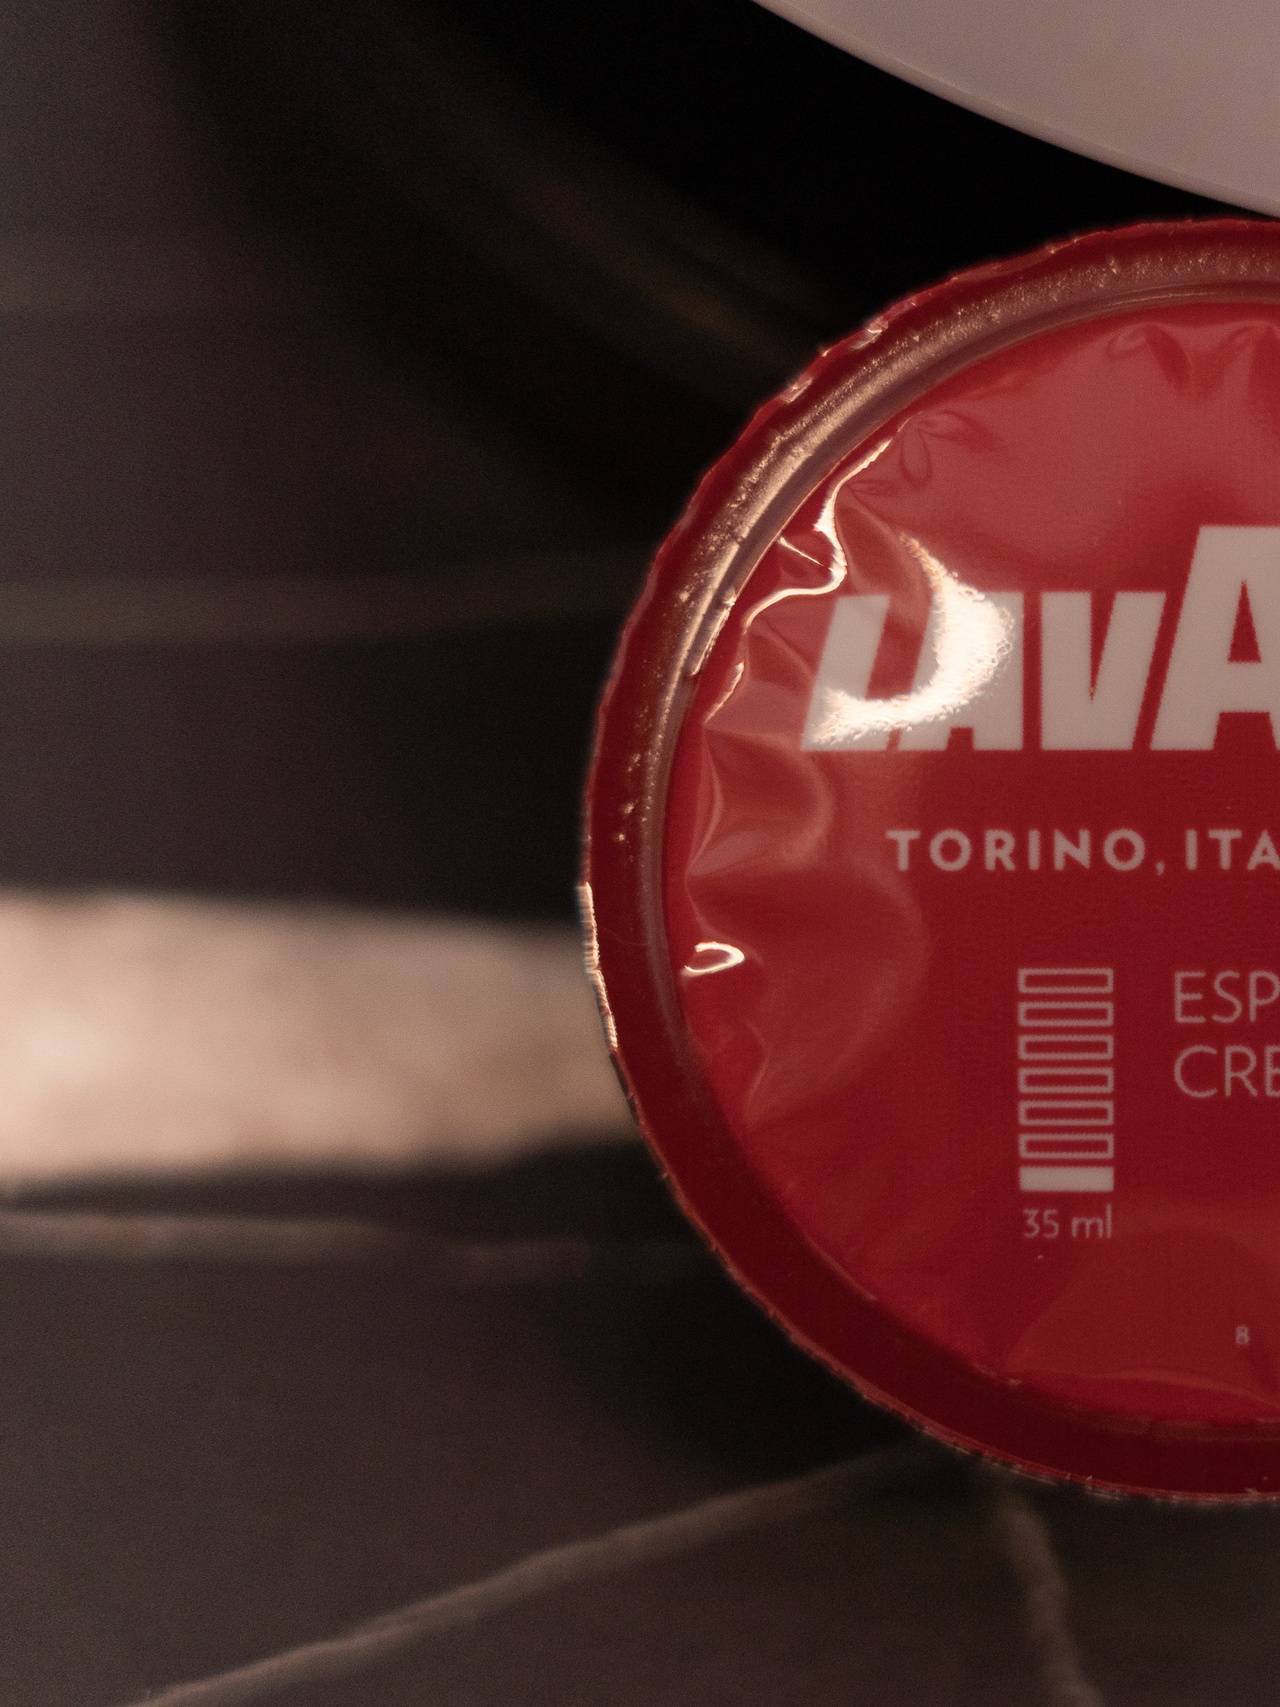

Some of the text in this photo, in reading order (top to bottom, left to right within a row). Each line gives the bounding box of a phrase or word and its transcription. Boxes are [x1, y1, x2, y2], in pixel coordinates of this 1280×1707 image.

[886, 827, 1168, 878] TORINO,
[1023, 1202, 1113, 1239] 35 ml
